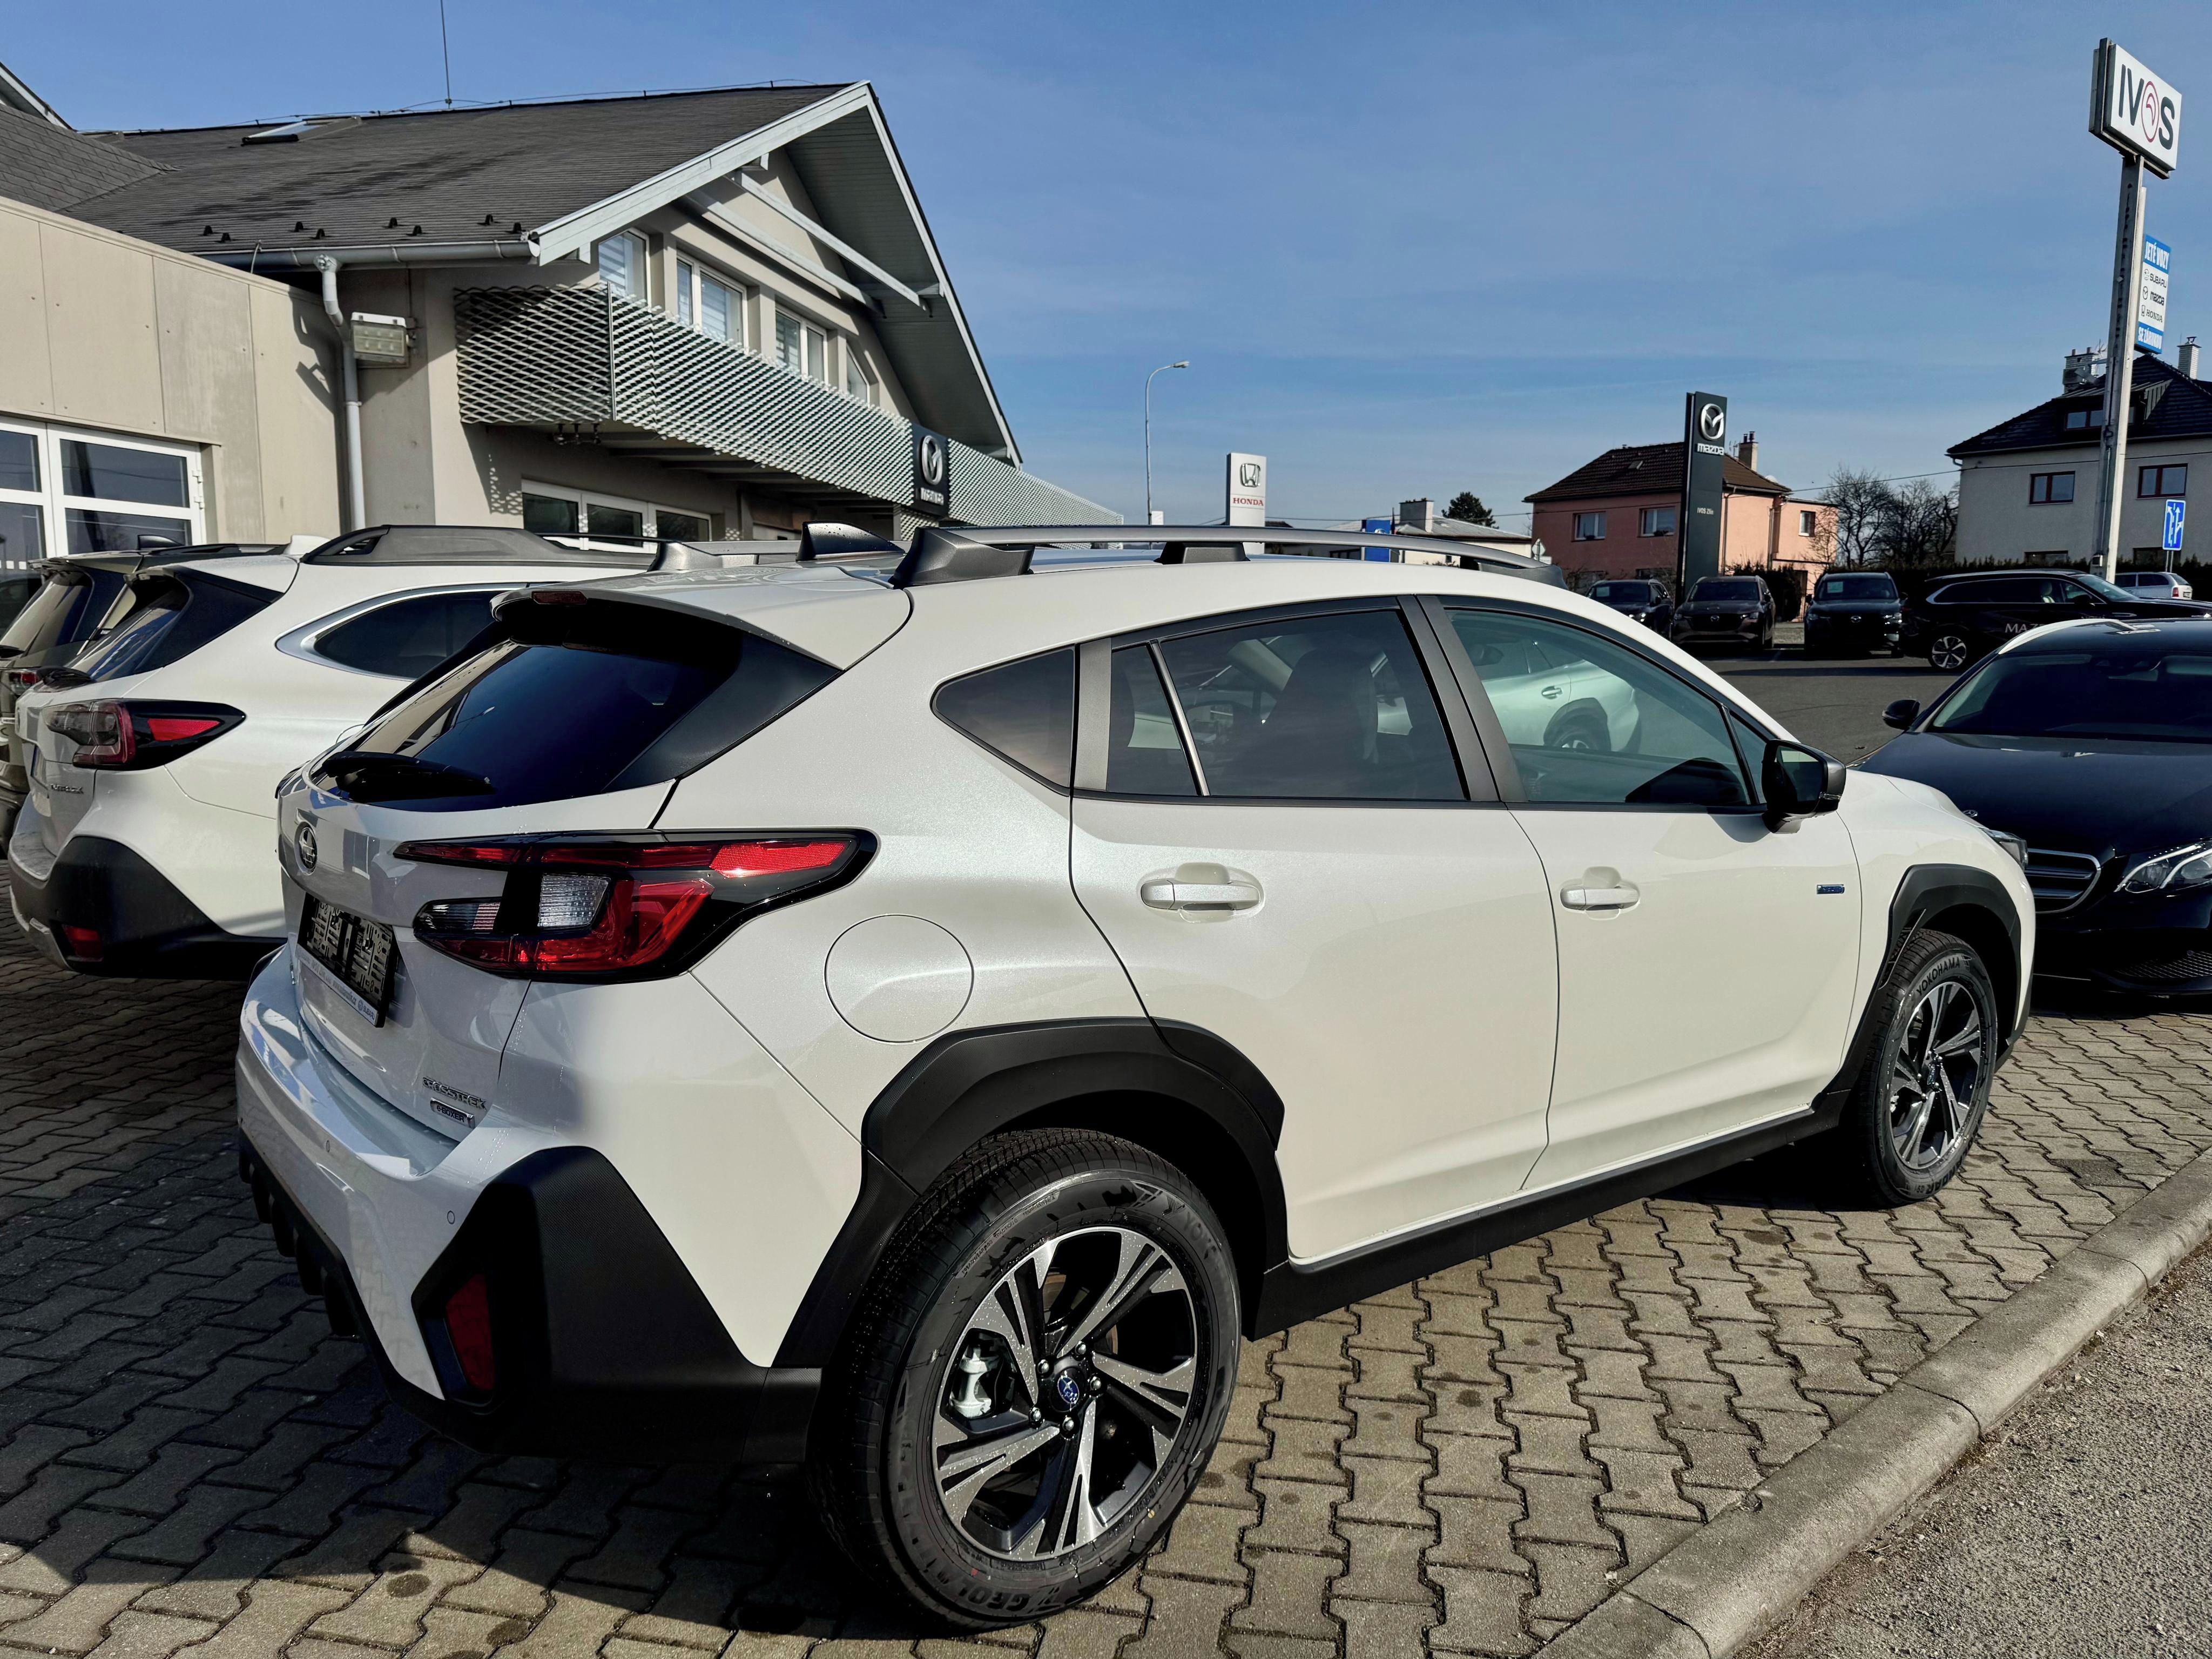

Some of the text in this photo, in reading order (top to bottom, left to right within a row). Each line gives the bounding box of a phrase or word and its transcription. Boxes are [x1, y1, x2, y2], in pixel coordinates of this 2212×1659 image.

[2150, 273, 2167, 288] SUBARU
[2146, 309, 2162, 322] HONDA
[1697, 443, 1724, 455] mazda
[1232, 497, 1264, 506] HONDA
[1917, 956, 1960, 995] YOKOHAMA
[423, 1076, 488, 1111] CROSSTREK
[436, 1104, 465, 1123] e-BOXER
